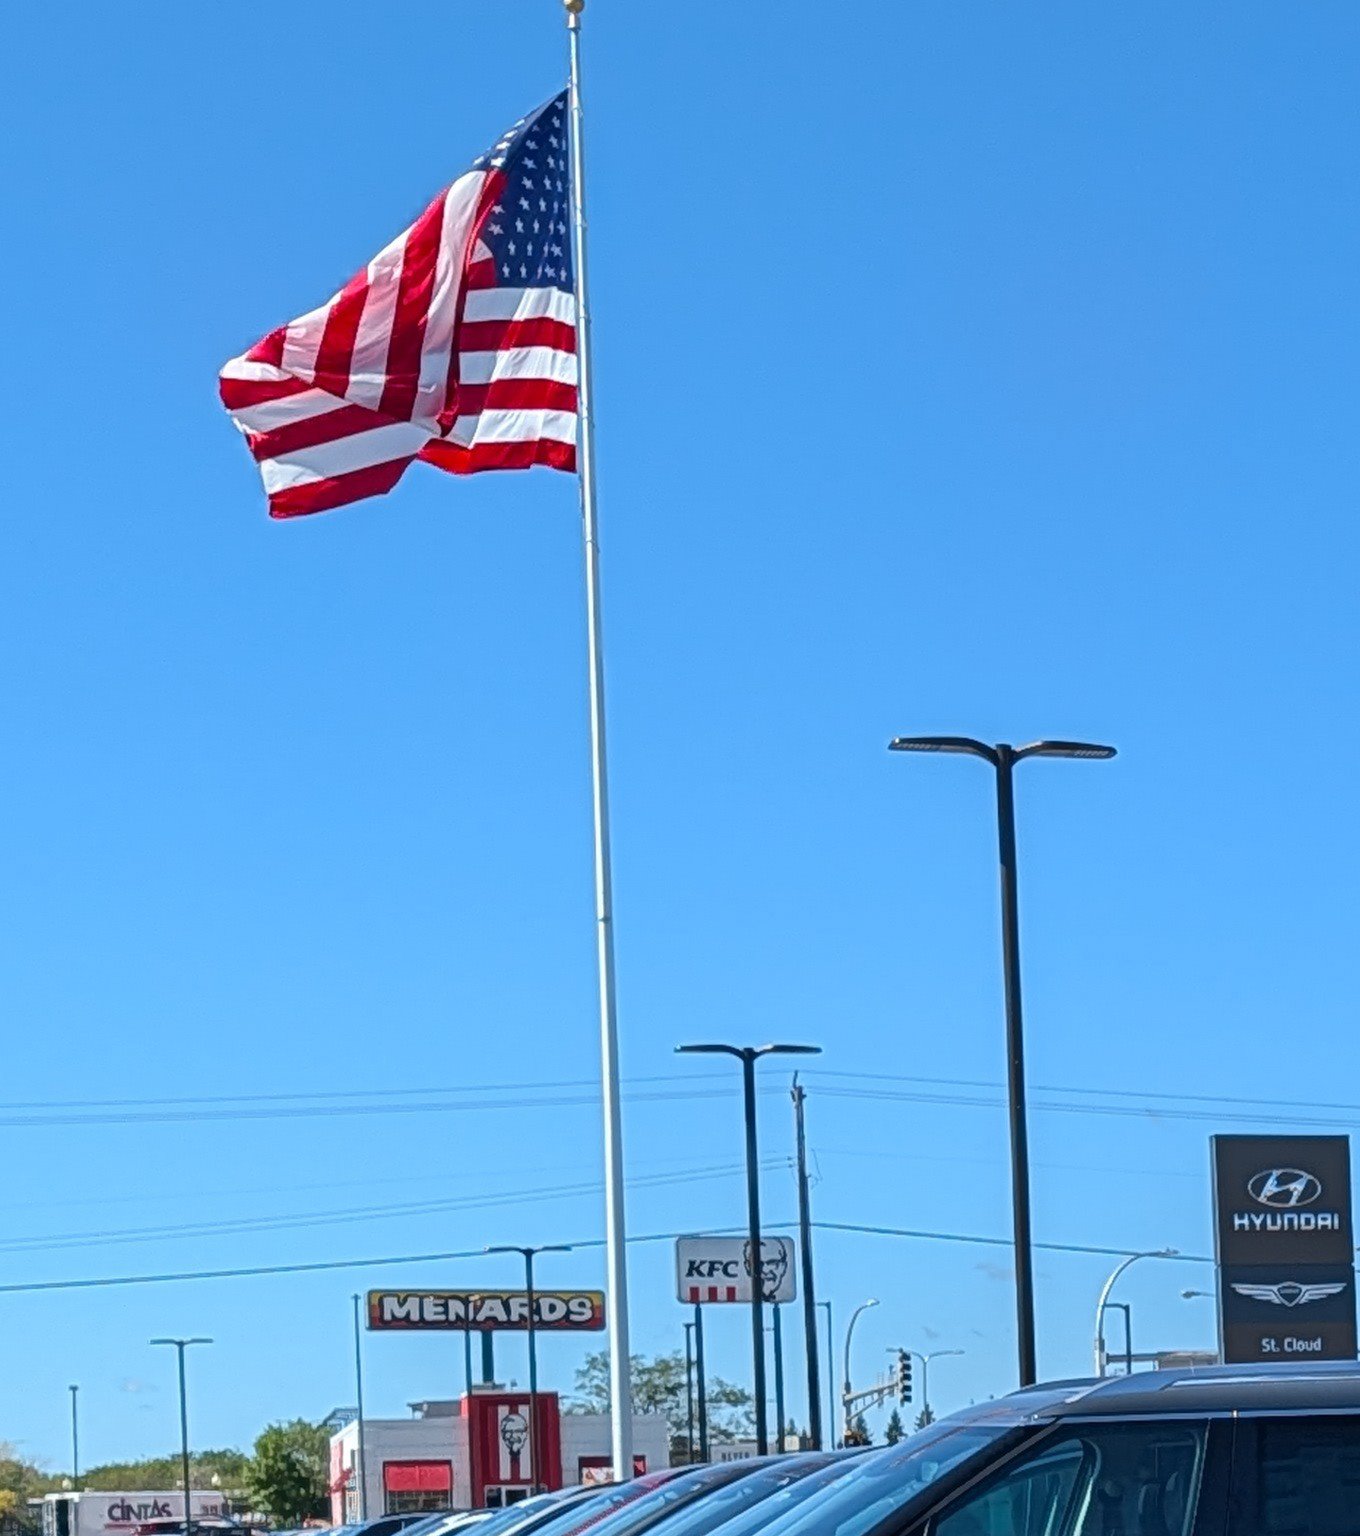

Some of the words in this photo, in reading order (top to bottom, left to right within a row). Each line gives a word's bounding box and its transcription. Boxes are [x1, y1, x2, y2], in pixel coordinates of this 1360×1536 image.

[1233, 1213, 1339, 1231] HYUNDAI
[685, 1259, 739, 1278] KFC
[383, 1294, 593, 1322] MENARDS
[1261, 1337, 1281, 1352] St.
[1283, 1336, 1322, 1352] Cloud
